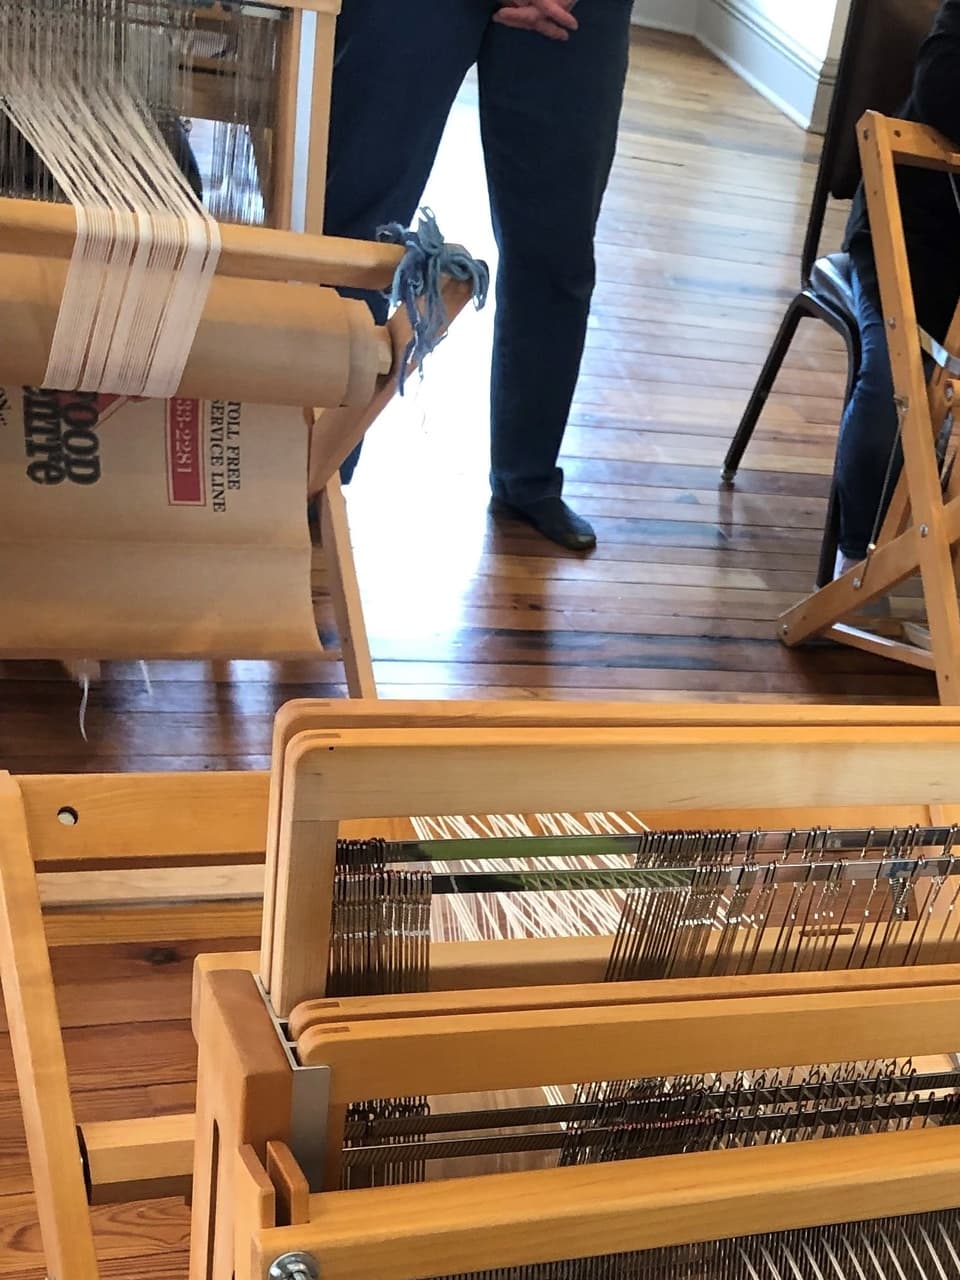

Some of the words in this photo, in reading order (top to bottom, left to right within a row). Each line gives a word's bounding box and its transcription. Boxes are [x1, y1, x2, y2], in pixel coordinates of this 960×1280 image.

[63, 391, 101, 485] OOD
[227, 400, 241, 439] TOLL
[227, 446, 240, 490] FREE
[212, 472, 226, 512] LINE
